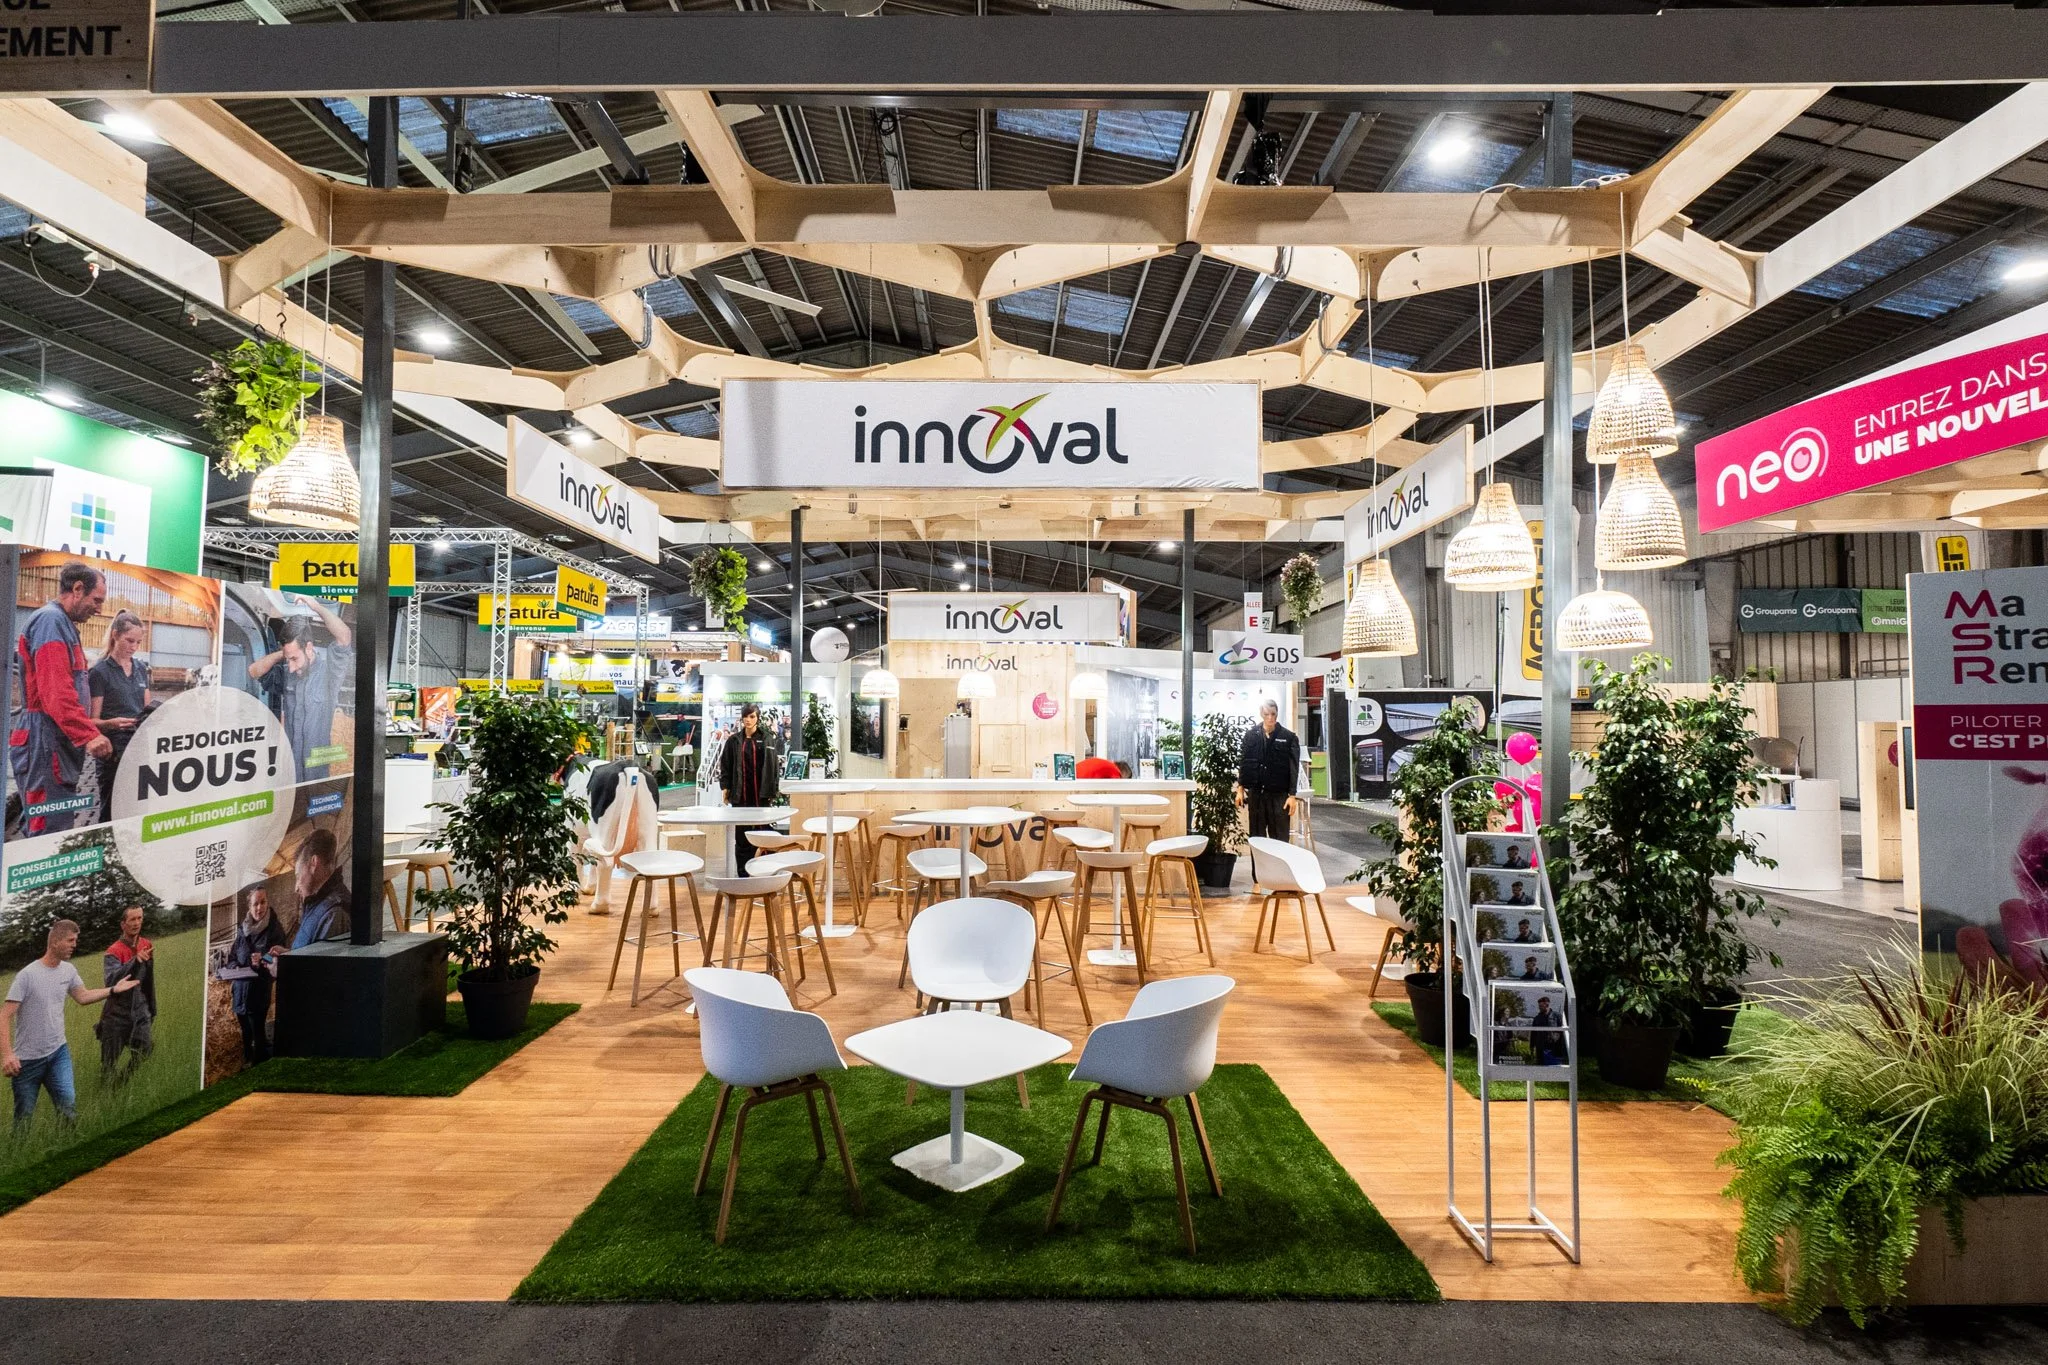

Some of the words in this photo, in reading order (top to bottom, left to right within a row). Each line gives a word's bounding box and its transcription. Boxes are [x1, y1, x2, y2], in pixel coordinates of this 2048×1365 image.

[1855, 385, 1952, 438] ENTREZ
[1961, 352, 2048, 402] DANS
[1855, 430, 1909, 465] UNE
[1917, 387, 2048, 447] NOUVEL
[1717, 436, 1820, 507] neo
[566, 583, 599, 607] patura
[1944, 589, 2025, 619] Ma
[496, 606, 560, 622] patura
[1249, 616, 1259, 627] E
[1755, 608, 1798, 616] Groupama
[1263, 646, 1300, 664] GDS
[1263, 665, 1294, 677] Bretagne
[1951, 715, 2042, 728] PILOTER
[156, 726, 265, 754] REJOIGNEZ
[1949, 734, 2020, 749] C'EST
[2028, 734, 2048, 749] P
[137, 749, 257, 801] NOUS
[267, 746, 278, 777] !
[28, 797, 91, 816] CONSULTANT
[151, 798, 267, 834] www.innoval.com
[11, 872, 55, 890] ÉLEVAGE
[56, 868, 68, 878] ET
[69, 859, 100, 875] SANTÉ
[12, 855, 71, 877] CONSEILLER
[72, 850, 100, 863] AGRO,
